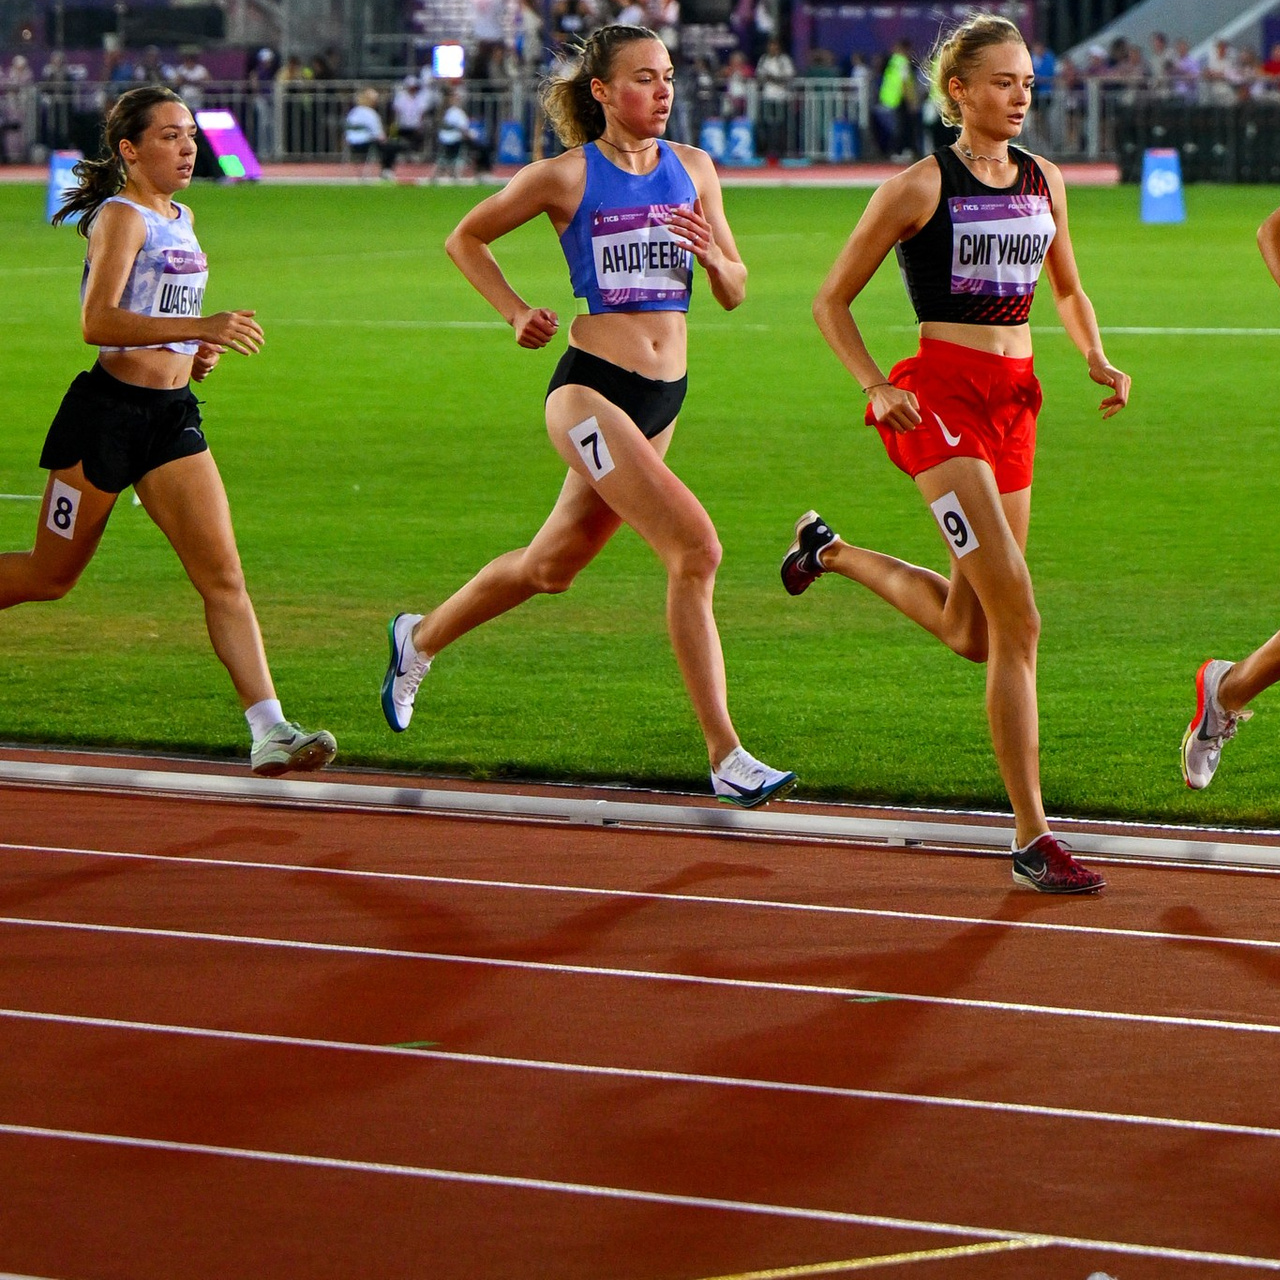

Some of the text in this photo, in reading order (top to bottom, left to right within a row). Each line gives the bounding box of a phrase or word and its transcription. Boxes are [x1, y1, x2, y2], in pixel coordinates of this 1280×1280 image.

[603, 215, 619, 223] ПСБ
[602, 241, 687, 274] АНДРЕЕВА
[959, 233, 1049, 266] СИГУНОВА
[580, 431, 602, 470] 7
[53, 496, 73, 530] 8
[943, 510, 968, 548] 9
